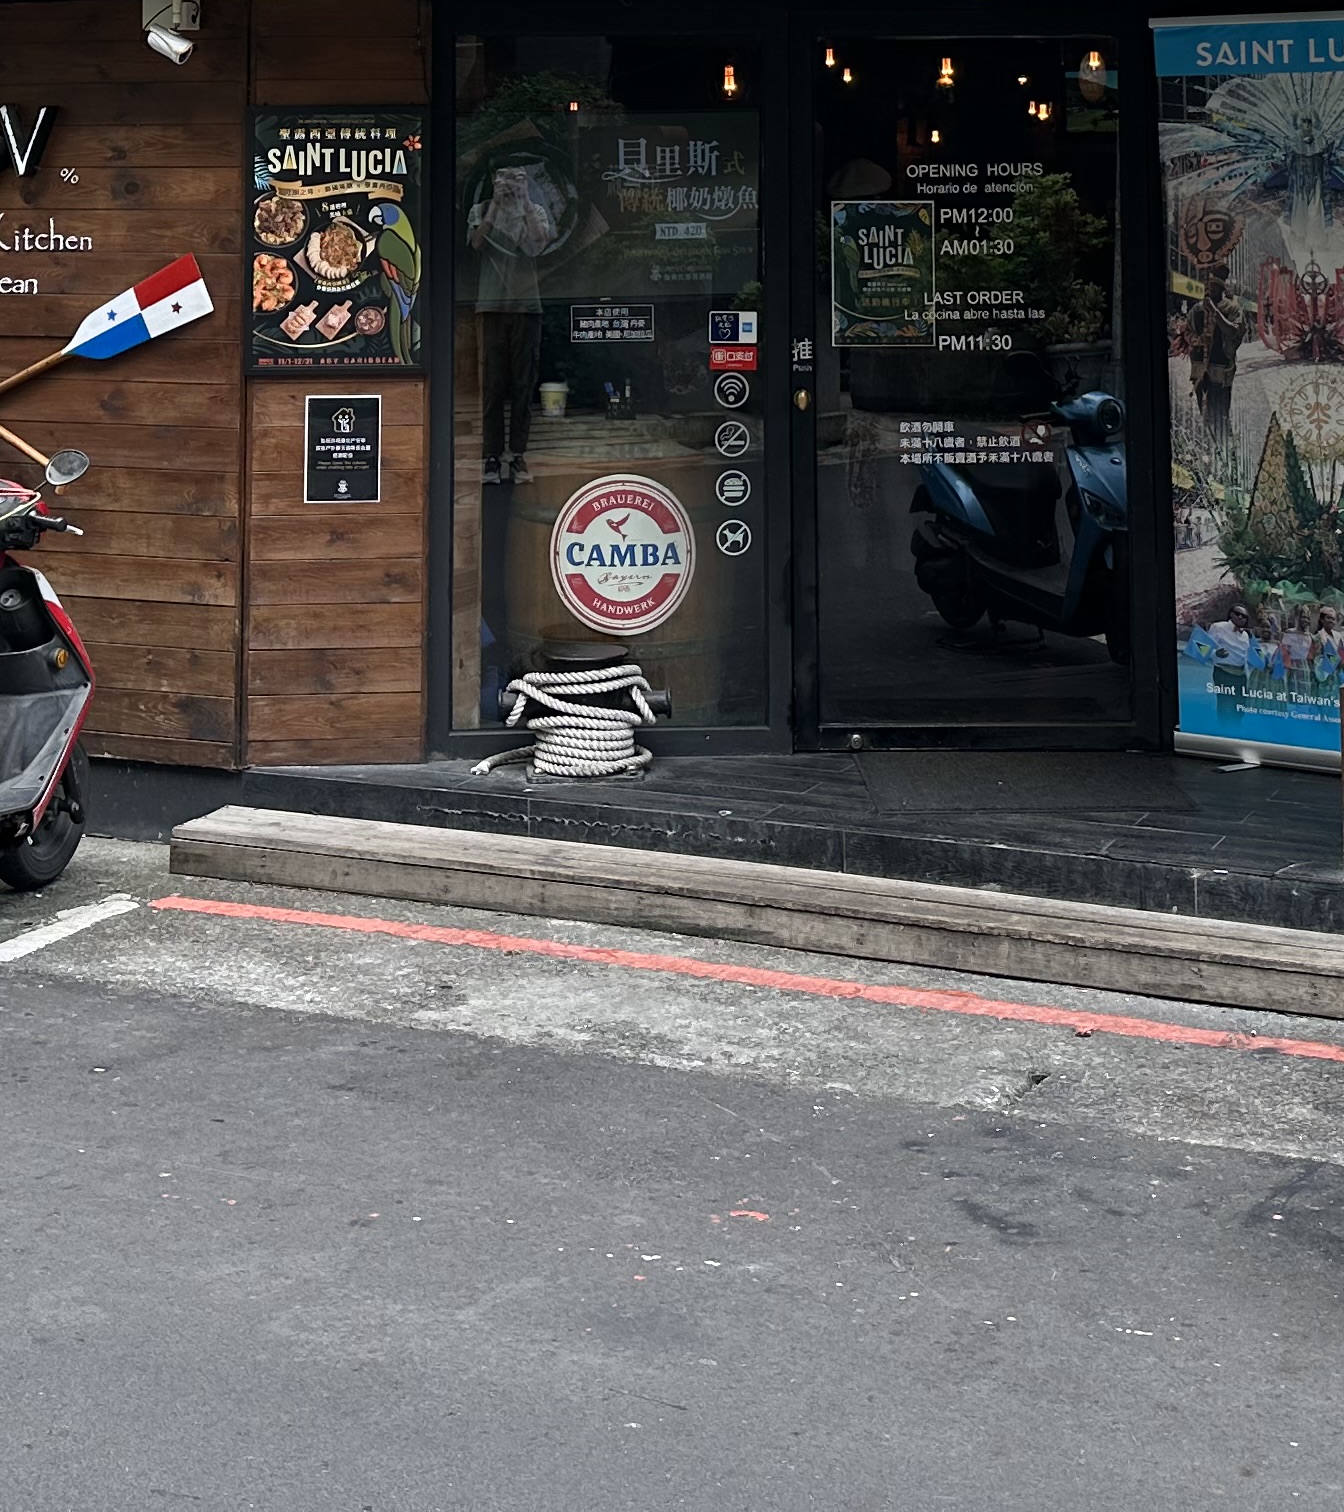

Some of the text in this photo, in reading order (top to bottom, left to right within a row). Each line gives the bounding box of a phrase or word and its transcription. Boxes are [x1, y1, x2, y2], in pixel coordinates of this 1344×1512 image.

[1195, 39, 1293, 67] SAINT
[267, 142, 408, 182] SAINT LUCIA
[617, 137, 745, 179] 貝里斯式
[906, 162, 1043, 178] OPENING HOURS
[917, 181, 959, 194] Horario
[963, 181, 977, 194] de
[940, 208, 1013, 223] PM12:00
[659, 225, 702, 237] NTD 420
[858, 225, 904, 246] SAINT
[940, 240, 1014, 255] AM01:30
[864, 246, 913, 270] LUCIA
[924, 291, 1024, 305] LAST ORDER
[904, 307, 1045, 320] La cocina abre hasta las
[792, 338, 813, 362] 推
[938, 336, 1012, 351] PM11:30
[793, 364, 812, 372] Push
[591, 494, 656, 513] BRAUEREI
[565, 540, 681, 569] CAMBA
[592, 596, 656, 616] HANDWERK
[1206, 682, 1340, 707] Saint Lucia at Taiwan's
[1291, 711, 1320, 722] General
